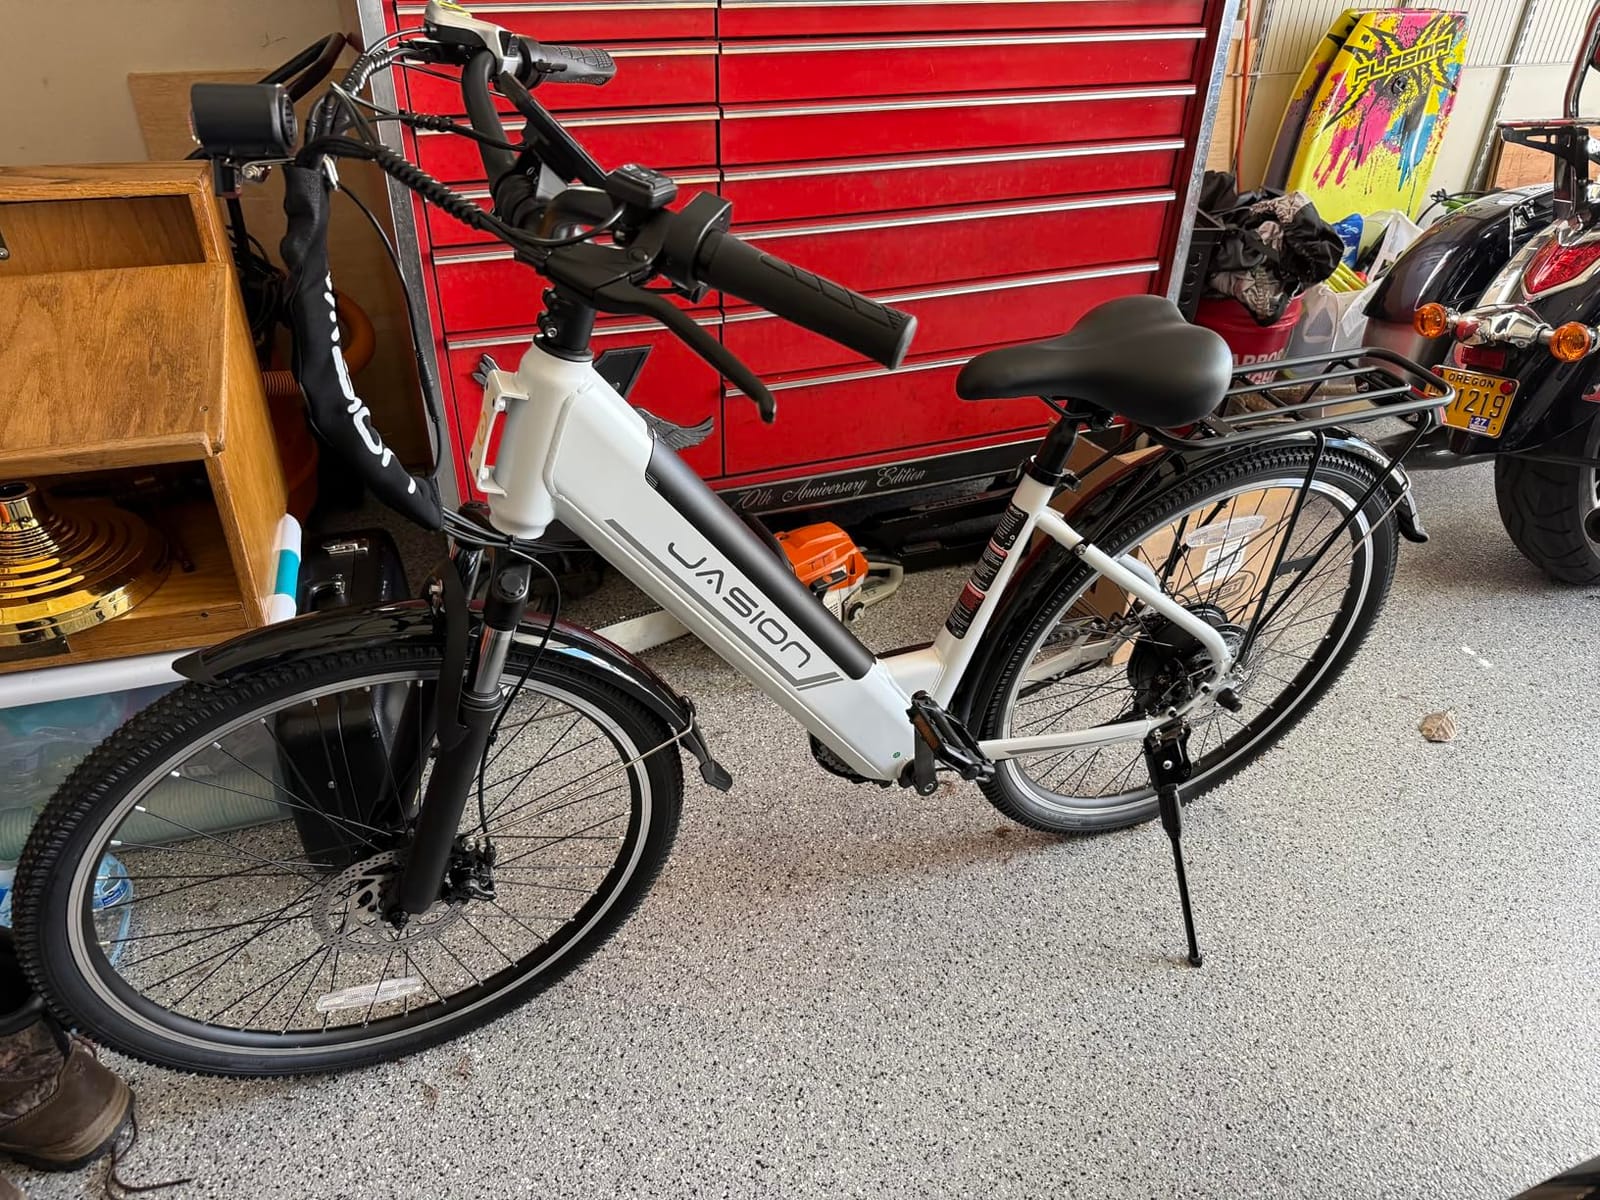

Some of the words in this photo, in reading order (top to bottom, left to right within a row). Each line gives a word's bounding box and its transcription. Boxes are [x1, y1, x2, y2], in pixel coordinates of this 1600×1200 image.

[1353, 35, 1452, 86] PLASMA
[1448, 373, 1496, 388] OREGON
[1474, 417, 1487, 426] 27
[782, 478, 868, 503] Anniversary
[877, 467, 926, 488] Edition
[667, 542, 811, 668] JASION
